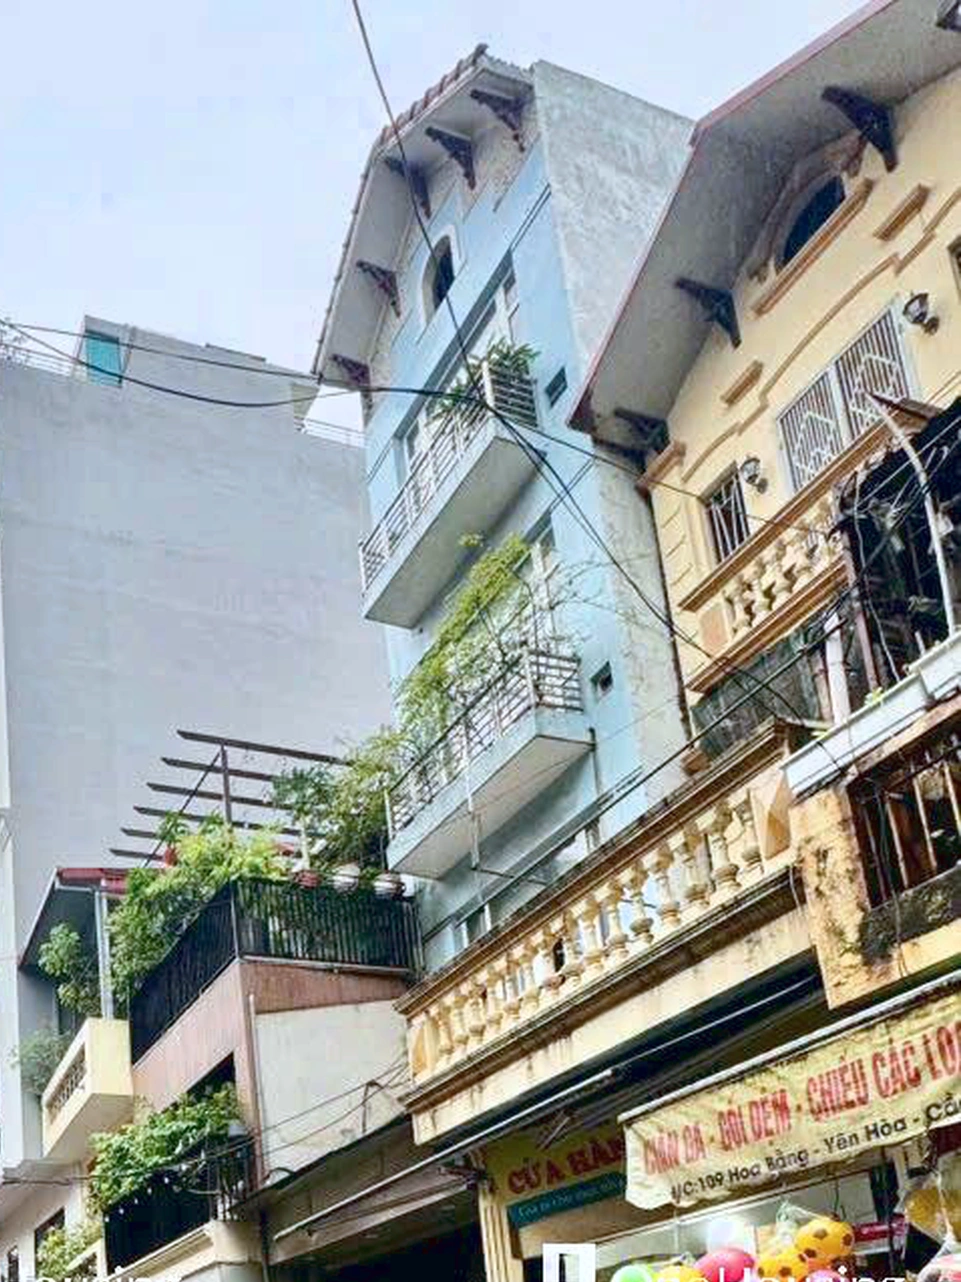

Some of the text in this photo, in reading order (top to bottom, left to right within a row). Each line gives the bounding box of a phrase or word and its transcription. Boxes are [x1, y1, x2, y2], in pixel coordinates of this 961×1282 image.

[872, 1039, 922, 1099] CÁC
[728, 1161, 761, 1183] Hoa
[824, 1132, 859, 1154] Yên
[865, 1117, 907, 1142] Hòa
